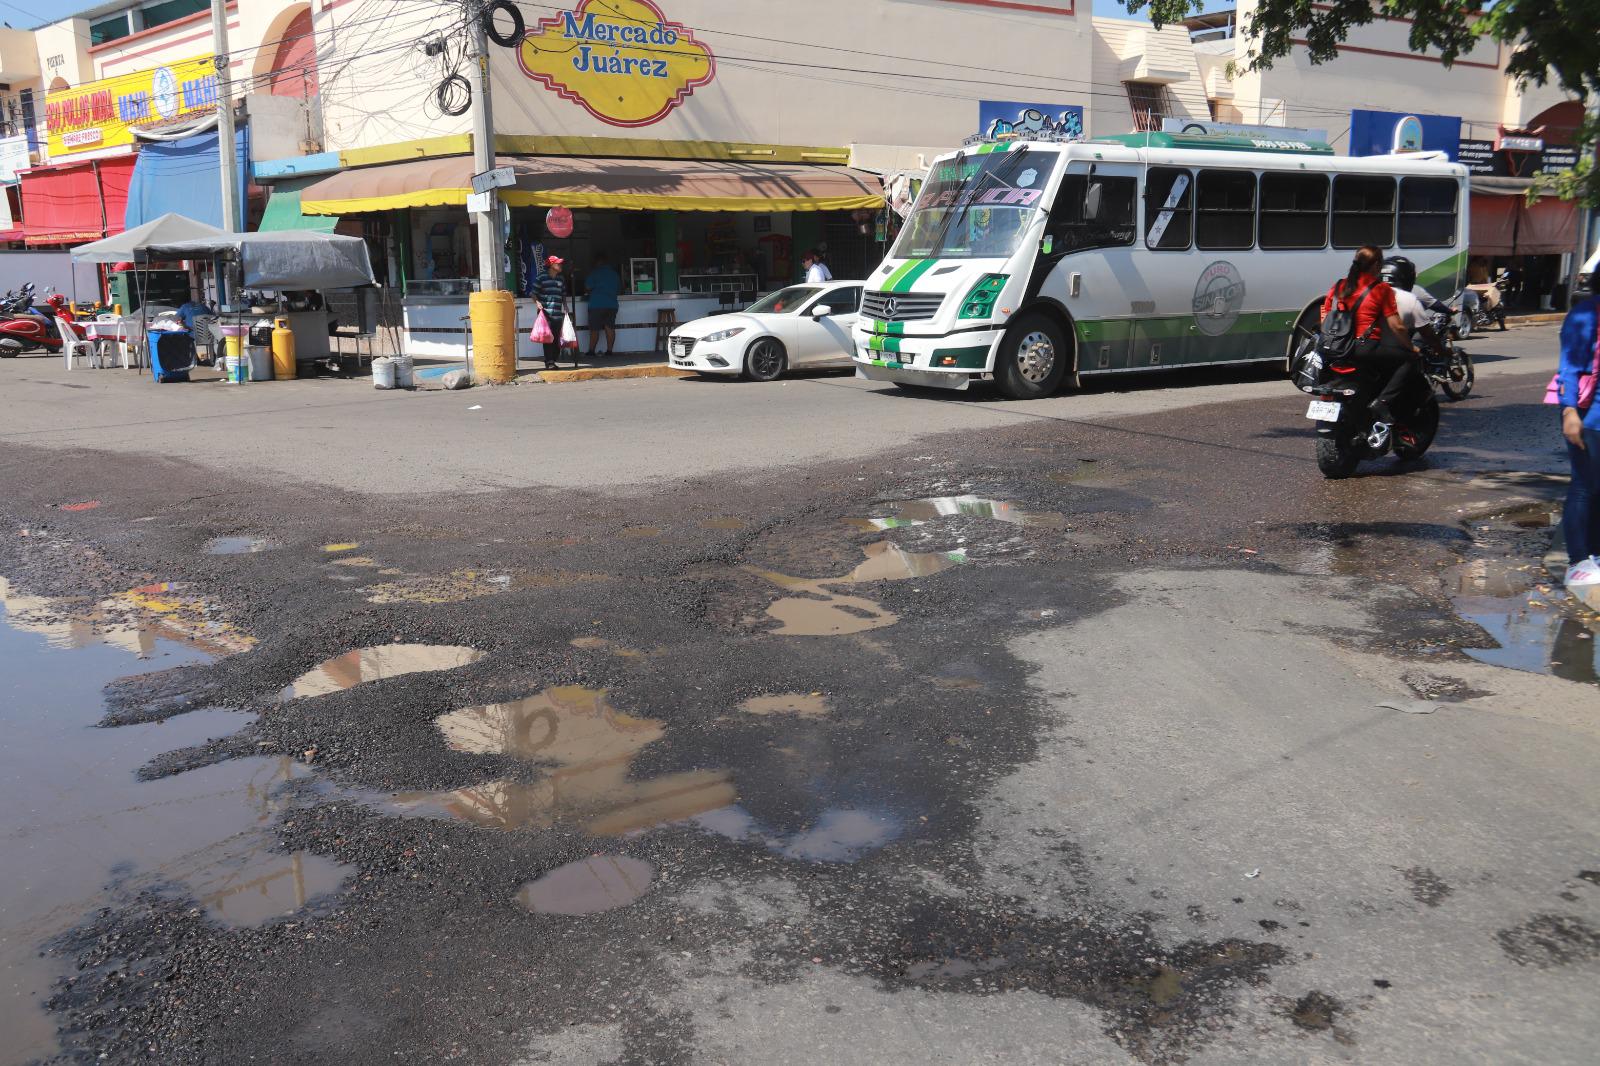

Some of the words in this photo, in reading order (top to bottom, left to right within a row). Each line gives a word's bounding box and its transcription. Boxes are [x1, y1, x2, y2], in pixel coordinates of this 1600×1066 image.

[563, 11, 678, 46] Mercado
[572, 46, 668, 78] Juárez
[1204, 265, 1231, 281] PURO
